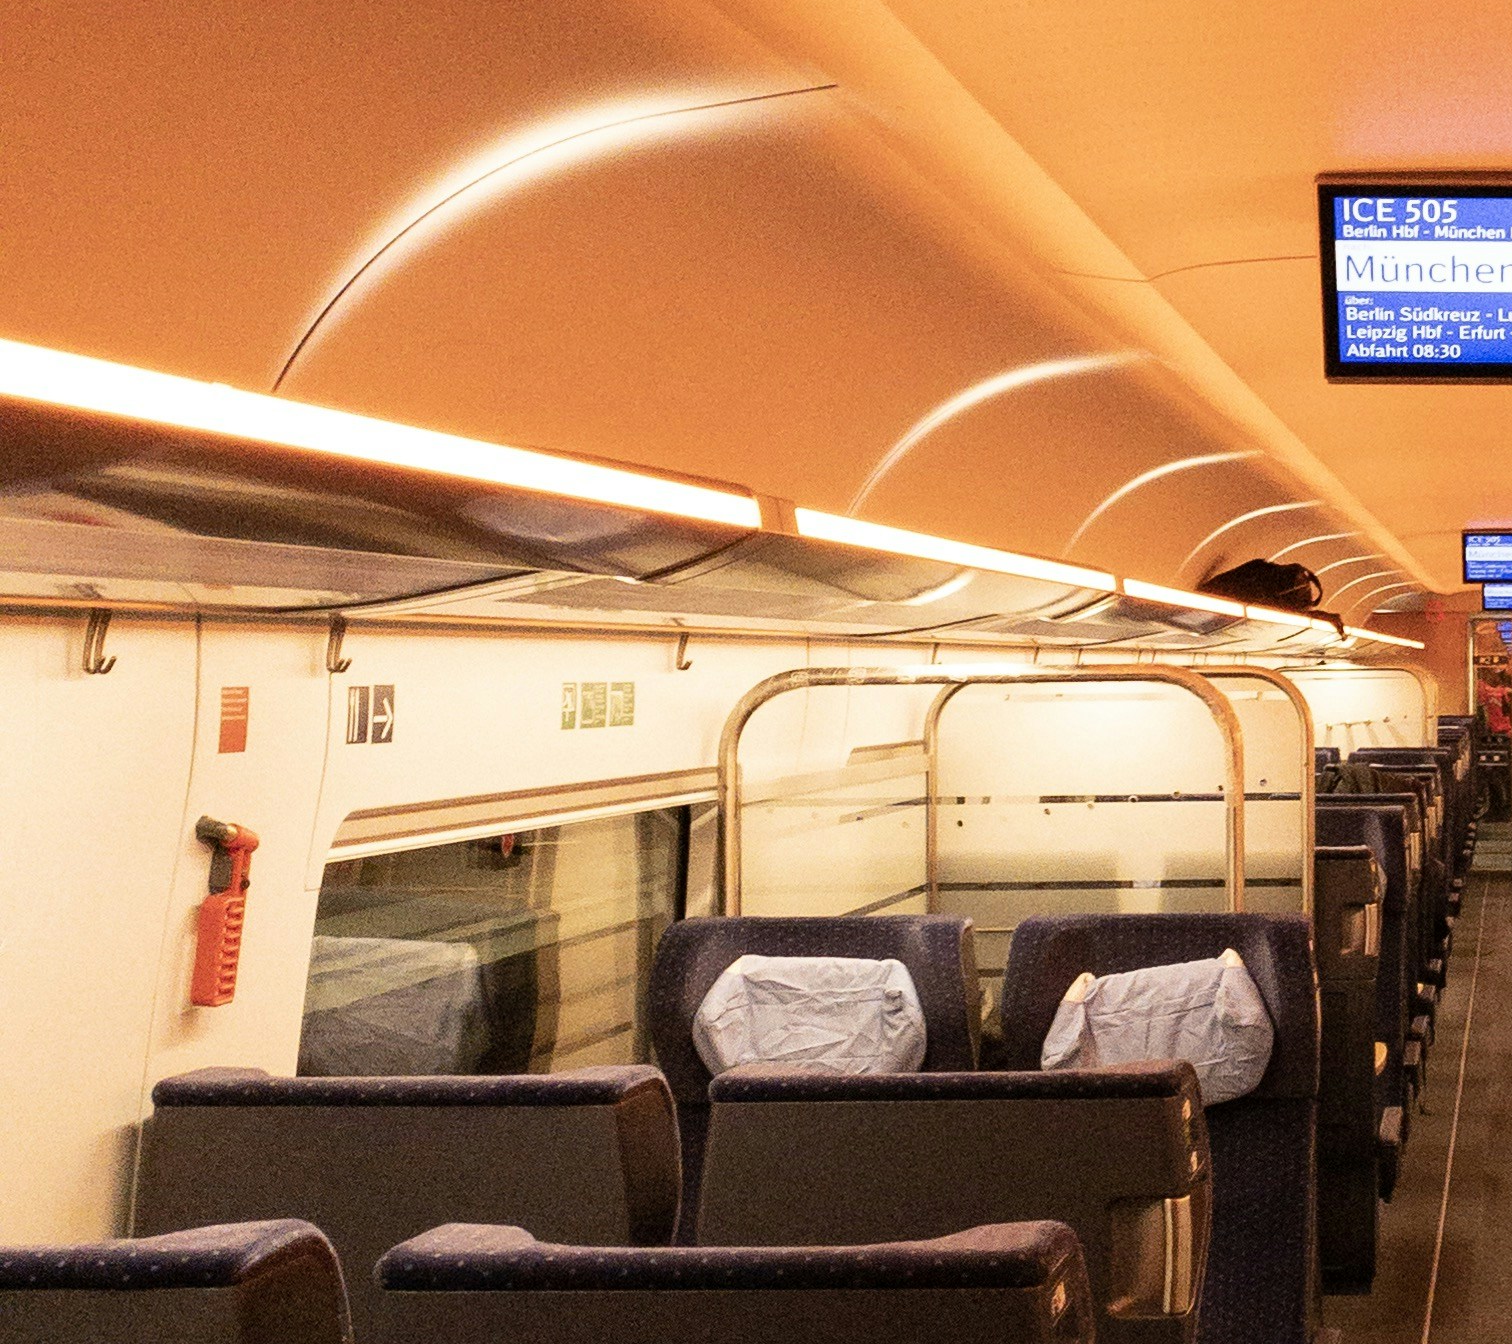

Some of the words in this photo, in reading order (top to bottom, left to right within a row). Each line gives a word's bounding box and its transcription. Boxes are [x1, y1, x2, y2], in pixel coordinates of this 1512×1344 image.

[1343, 198, 1396, 222] ICE
[1405, 199, 1458, 224] 505
[1343, 224, 1387, 238] Berlin
[1392, 225, 1420, 238] Hbf
[1434, 225, 1506, 239] München
[1345, 306, 1395, 321] Berlin
[1399, 306, 1481, 322] Südkreuz
[1346, 324, 1408, 342] Leipzig
[1412, 324, 1443, 339] Hbf
[1459, 325, 1506, 340] Erfurt
[1346, 343, 1409, 358] Abfahrt
[1412, 344, 1461, 359] 08:30
